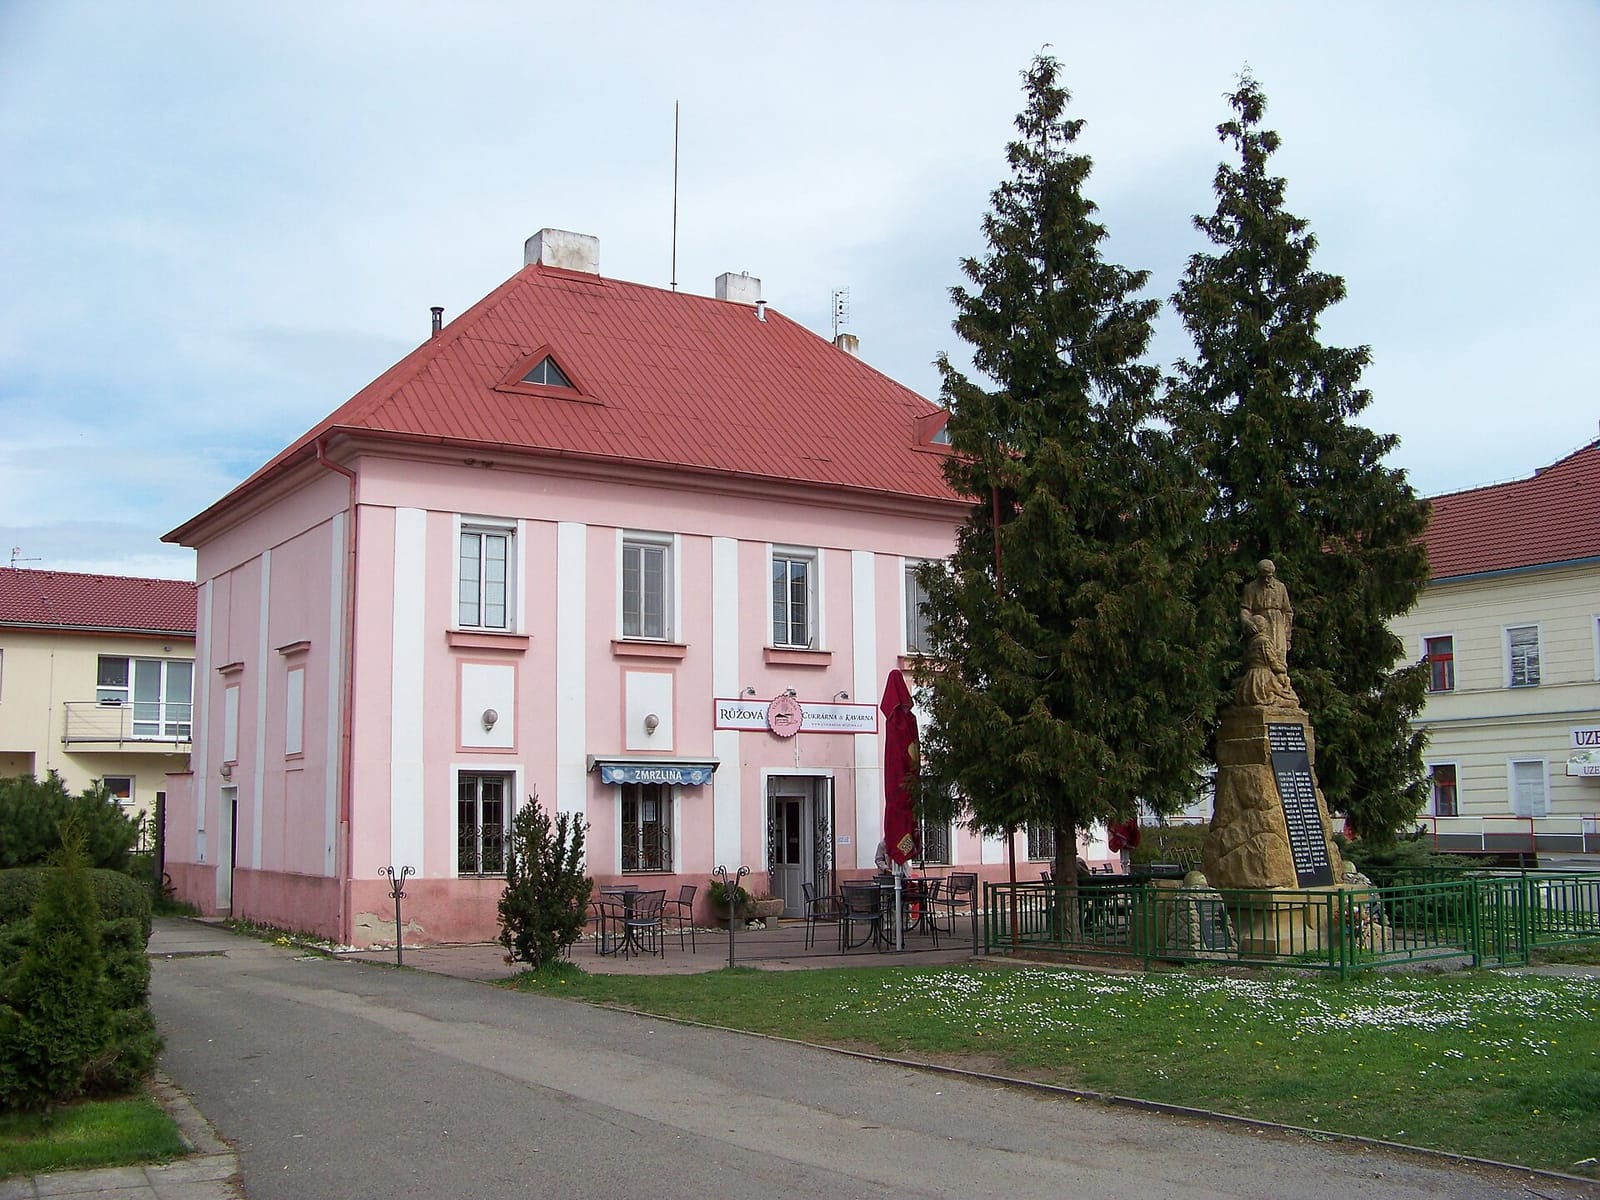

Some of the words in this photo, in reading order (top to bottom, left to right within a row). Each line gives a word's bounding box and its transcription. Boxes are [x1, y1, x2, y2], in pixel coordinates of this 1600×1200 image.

[720, 706, 764, 720] RŮŽOVÁ
[845, 713, 874, 721] KAVÁRNA
[635, 770, 682, 780] ZMRZLINA
